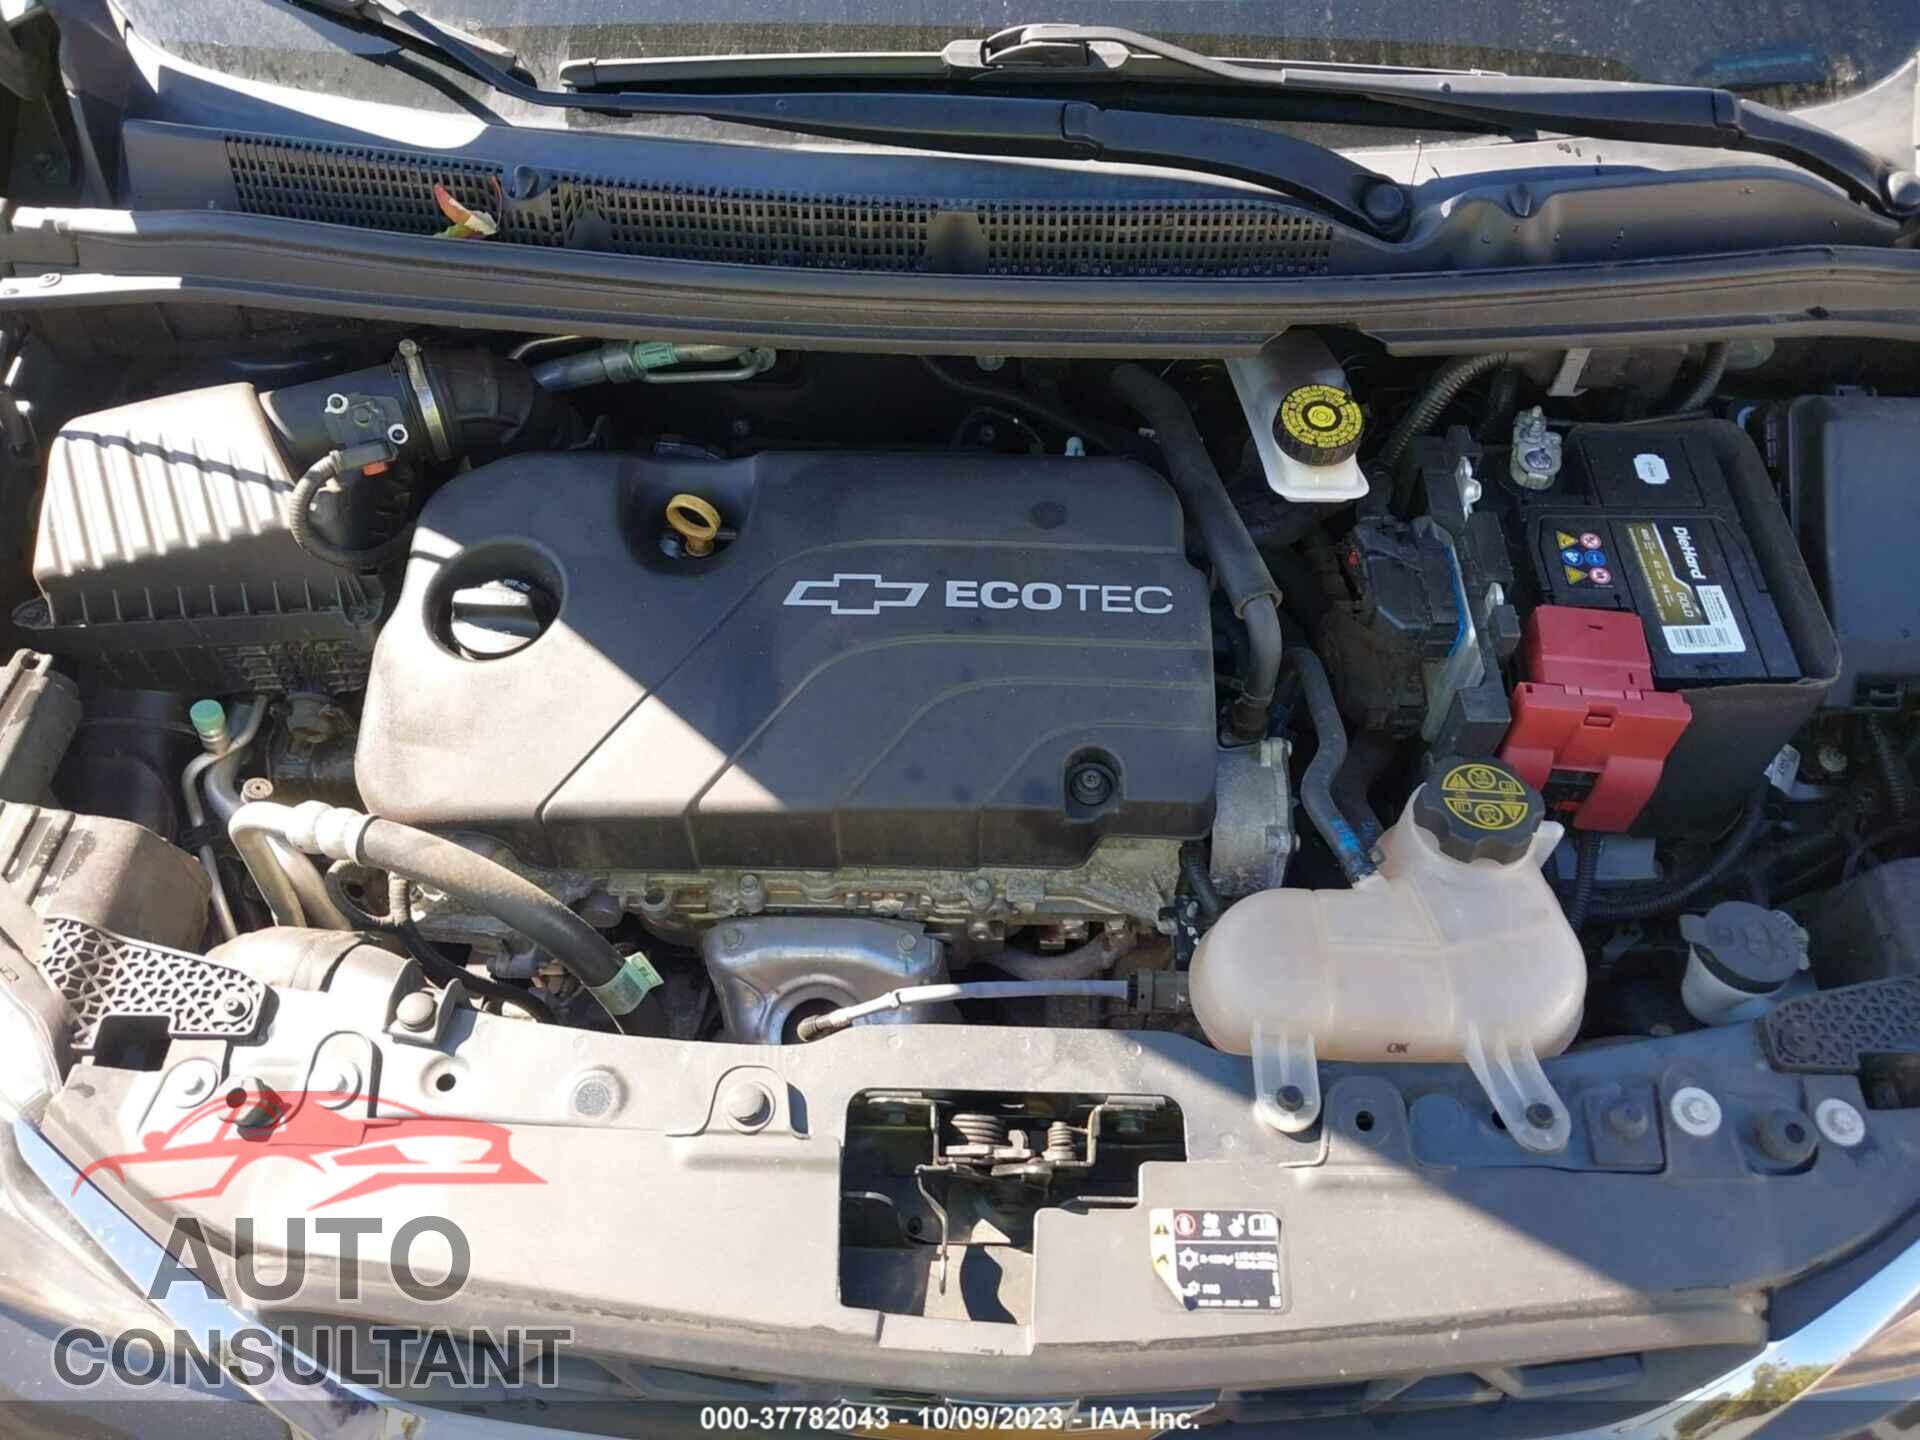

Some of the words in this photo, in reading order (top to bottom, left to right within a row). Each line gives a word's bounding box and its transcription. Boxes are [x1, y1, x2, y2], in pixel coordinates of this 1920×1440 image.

[1672, 526, 1707, 580] DieHard
[945, 580, 1174, 615] ECOTEC
[1676, 591, 1695, 618] GOLD
[1386, 1042, 1409, 1055] OK
